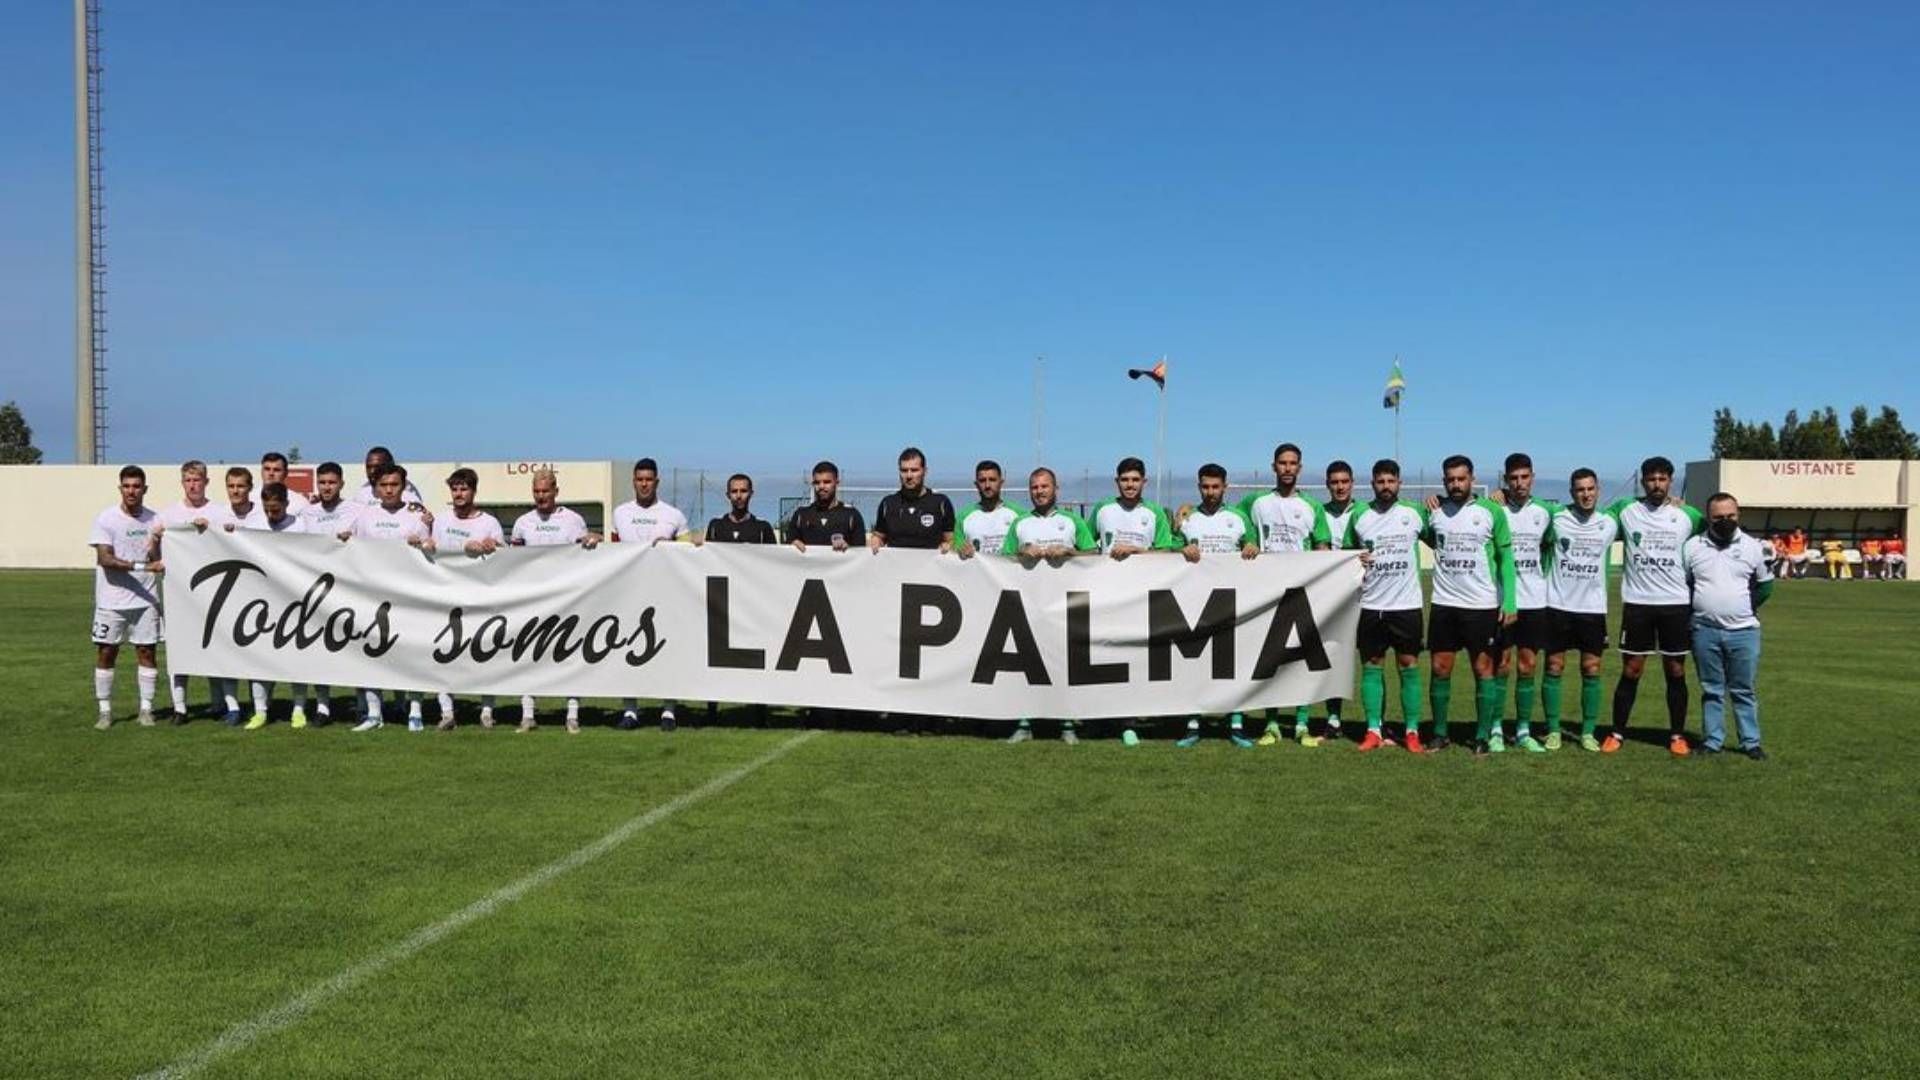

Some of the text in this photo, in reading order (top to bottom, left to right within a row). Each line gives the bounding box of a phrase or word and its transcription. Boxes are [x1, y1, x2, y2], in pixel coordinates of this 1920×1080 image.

[1770, 462, 1856, 475] VISITANTE
[1368, 559, 1409, 571] Fuerza
[1440, 555, 1476, 569] Fuerza
[1514, 559, 1537, 569] erza
[1560, 559, 1599, 574] Fuerza
[1633, 553, 1676, 567] Fuerza
[190, 559, 1331, 687] Todos somos LA PALMA
